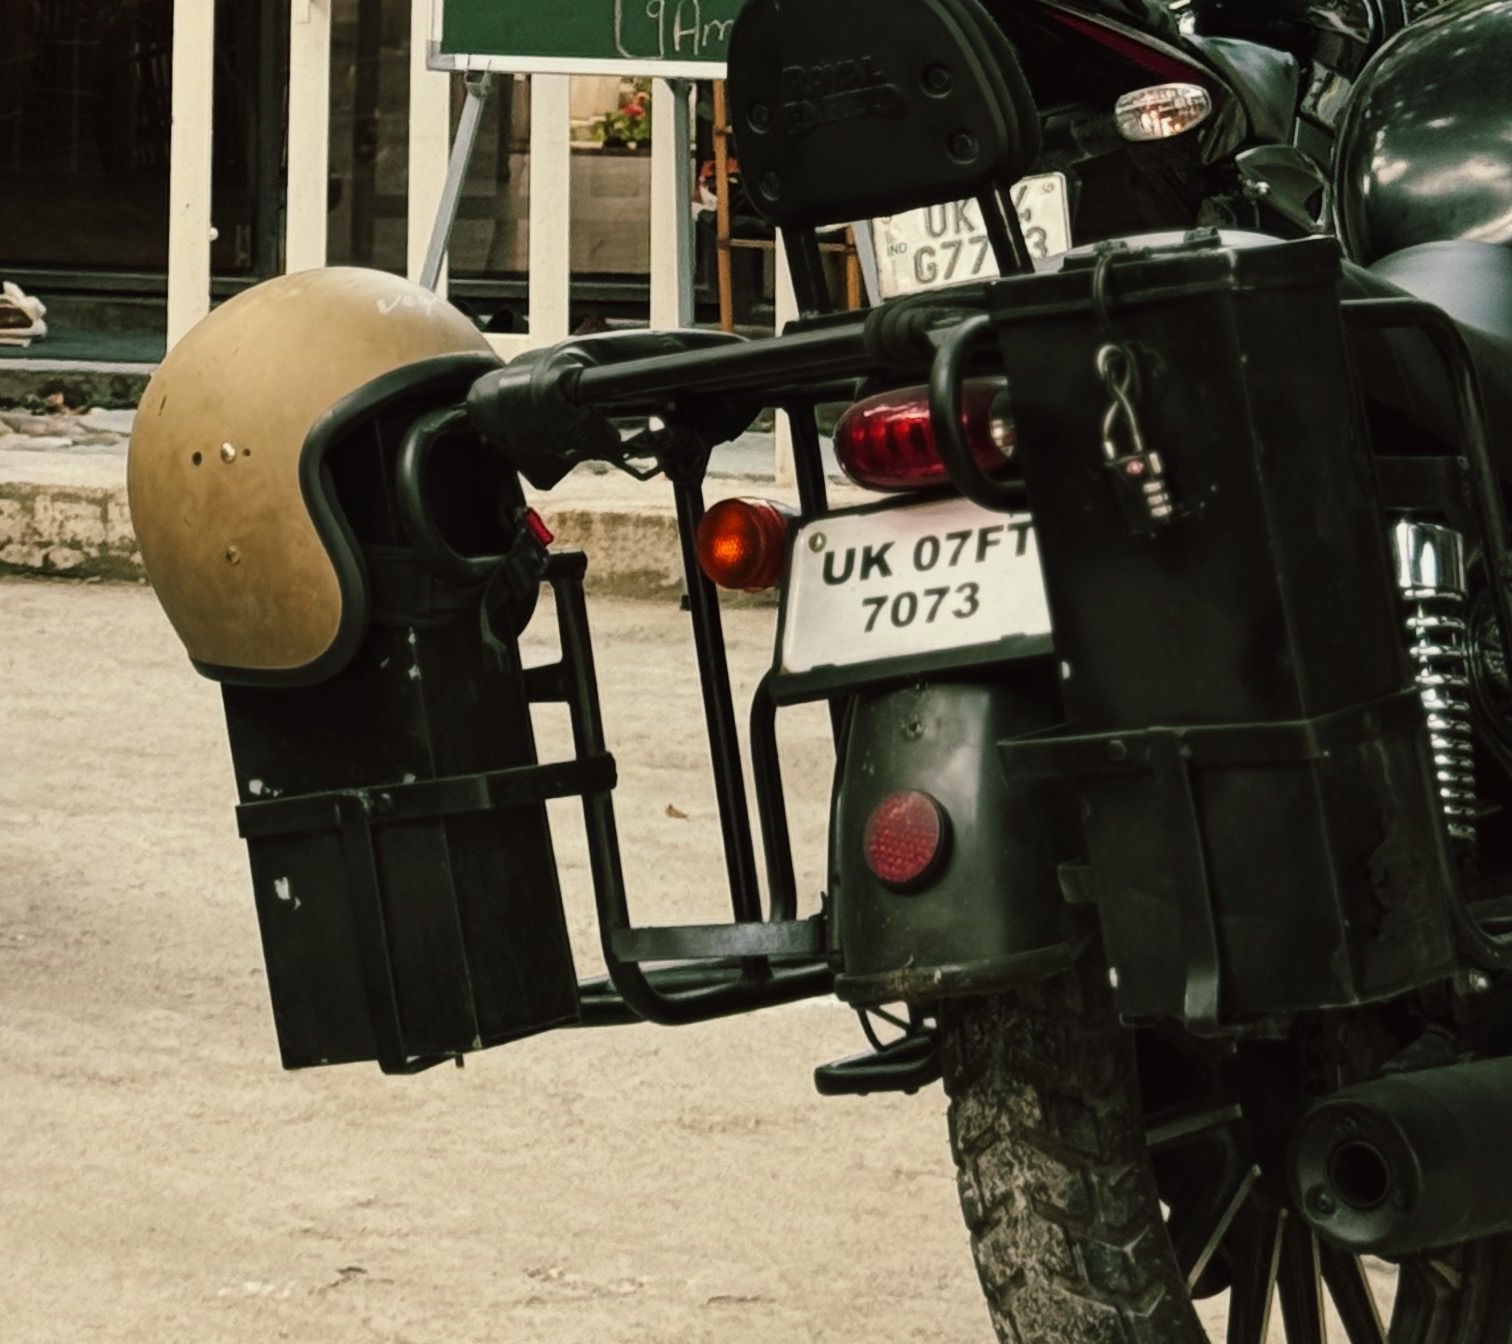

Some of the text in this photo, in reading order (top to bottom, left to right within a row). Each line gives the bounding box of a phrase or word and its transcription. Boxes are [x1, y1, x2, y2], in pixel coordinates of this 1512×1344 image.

[914, 226, 1048, 285] G773
[822, 520, 1033, 586] UK 07FT
[861, 582, 981, 633] 7073
